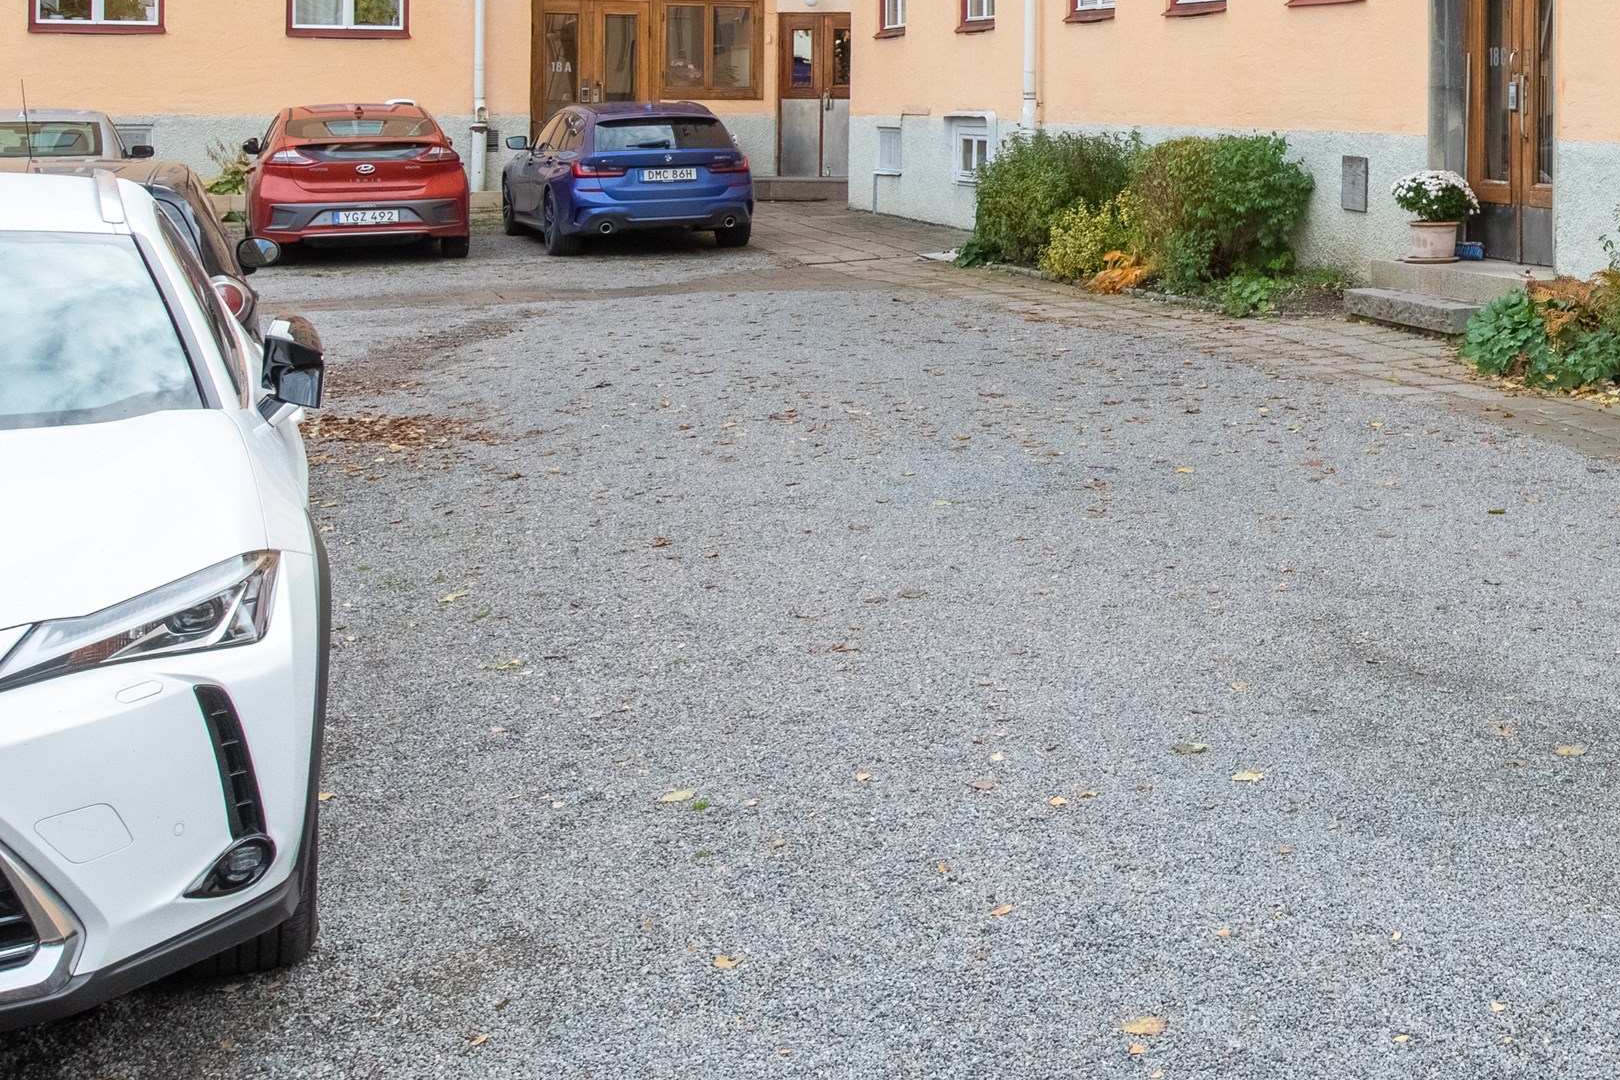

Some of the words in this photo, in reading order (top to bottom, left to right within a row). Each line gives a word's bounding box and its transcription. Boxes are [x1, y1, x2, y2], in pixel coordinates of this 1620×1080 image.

[1489, 46, 1499, 66] 18
[551, 61, 563, 72] 18
[564, 61, 572, 72] A
[648, 169, 669, 180] DMC
[671, 168, 693, 179] 86H
[344, 212, 367, 222] YGZ
[371, 211, 394, 221] 492
